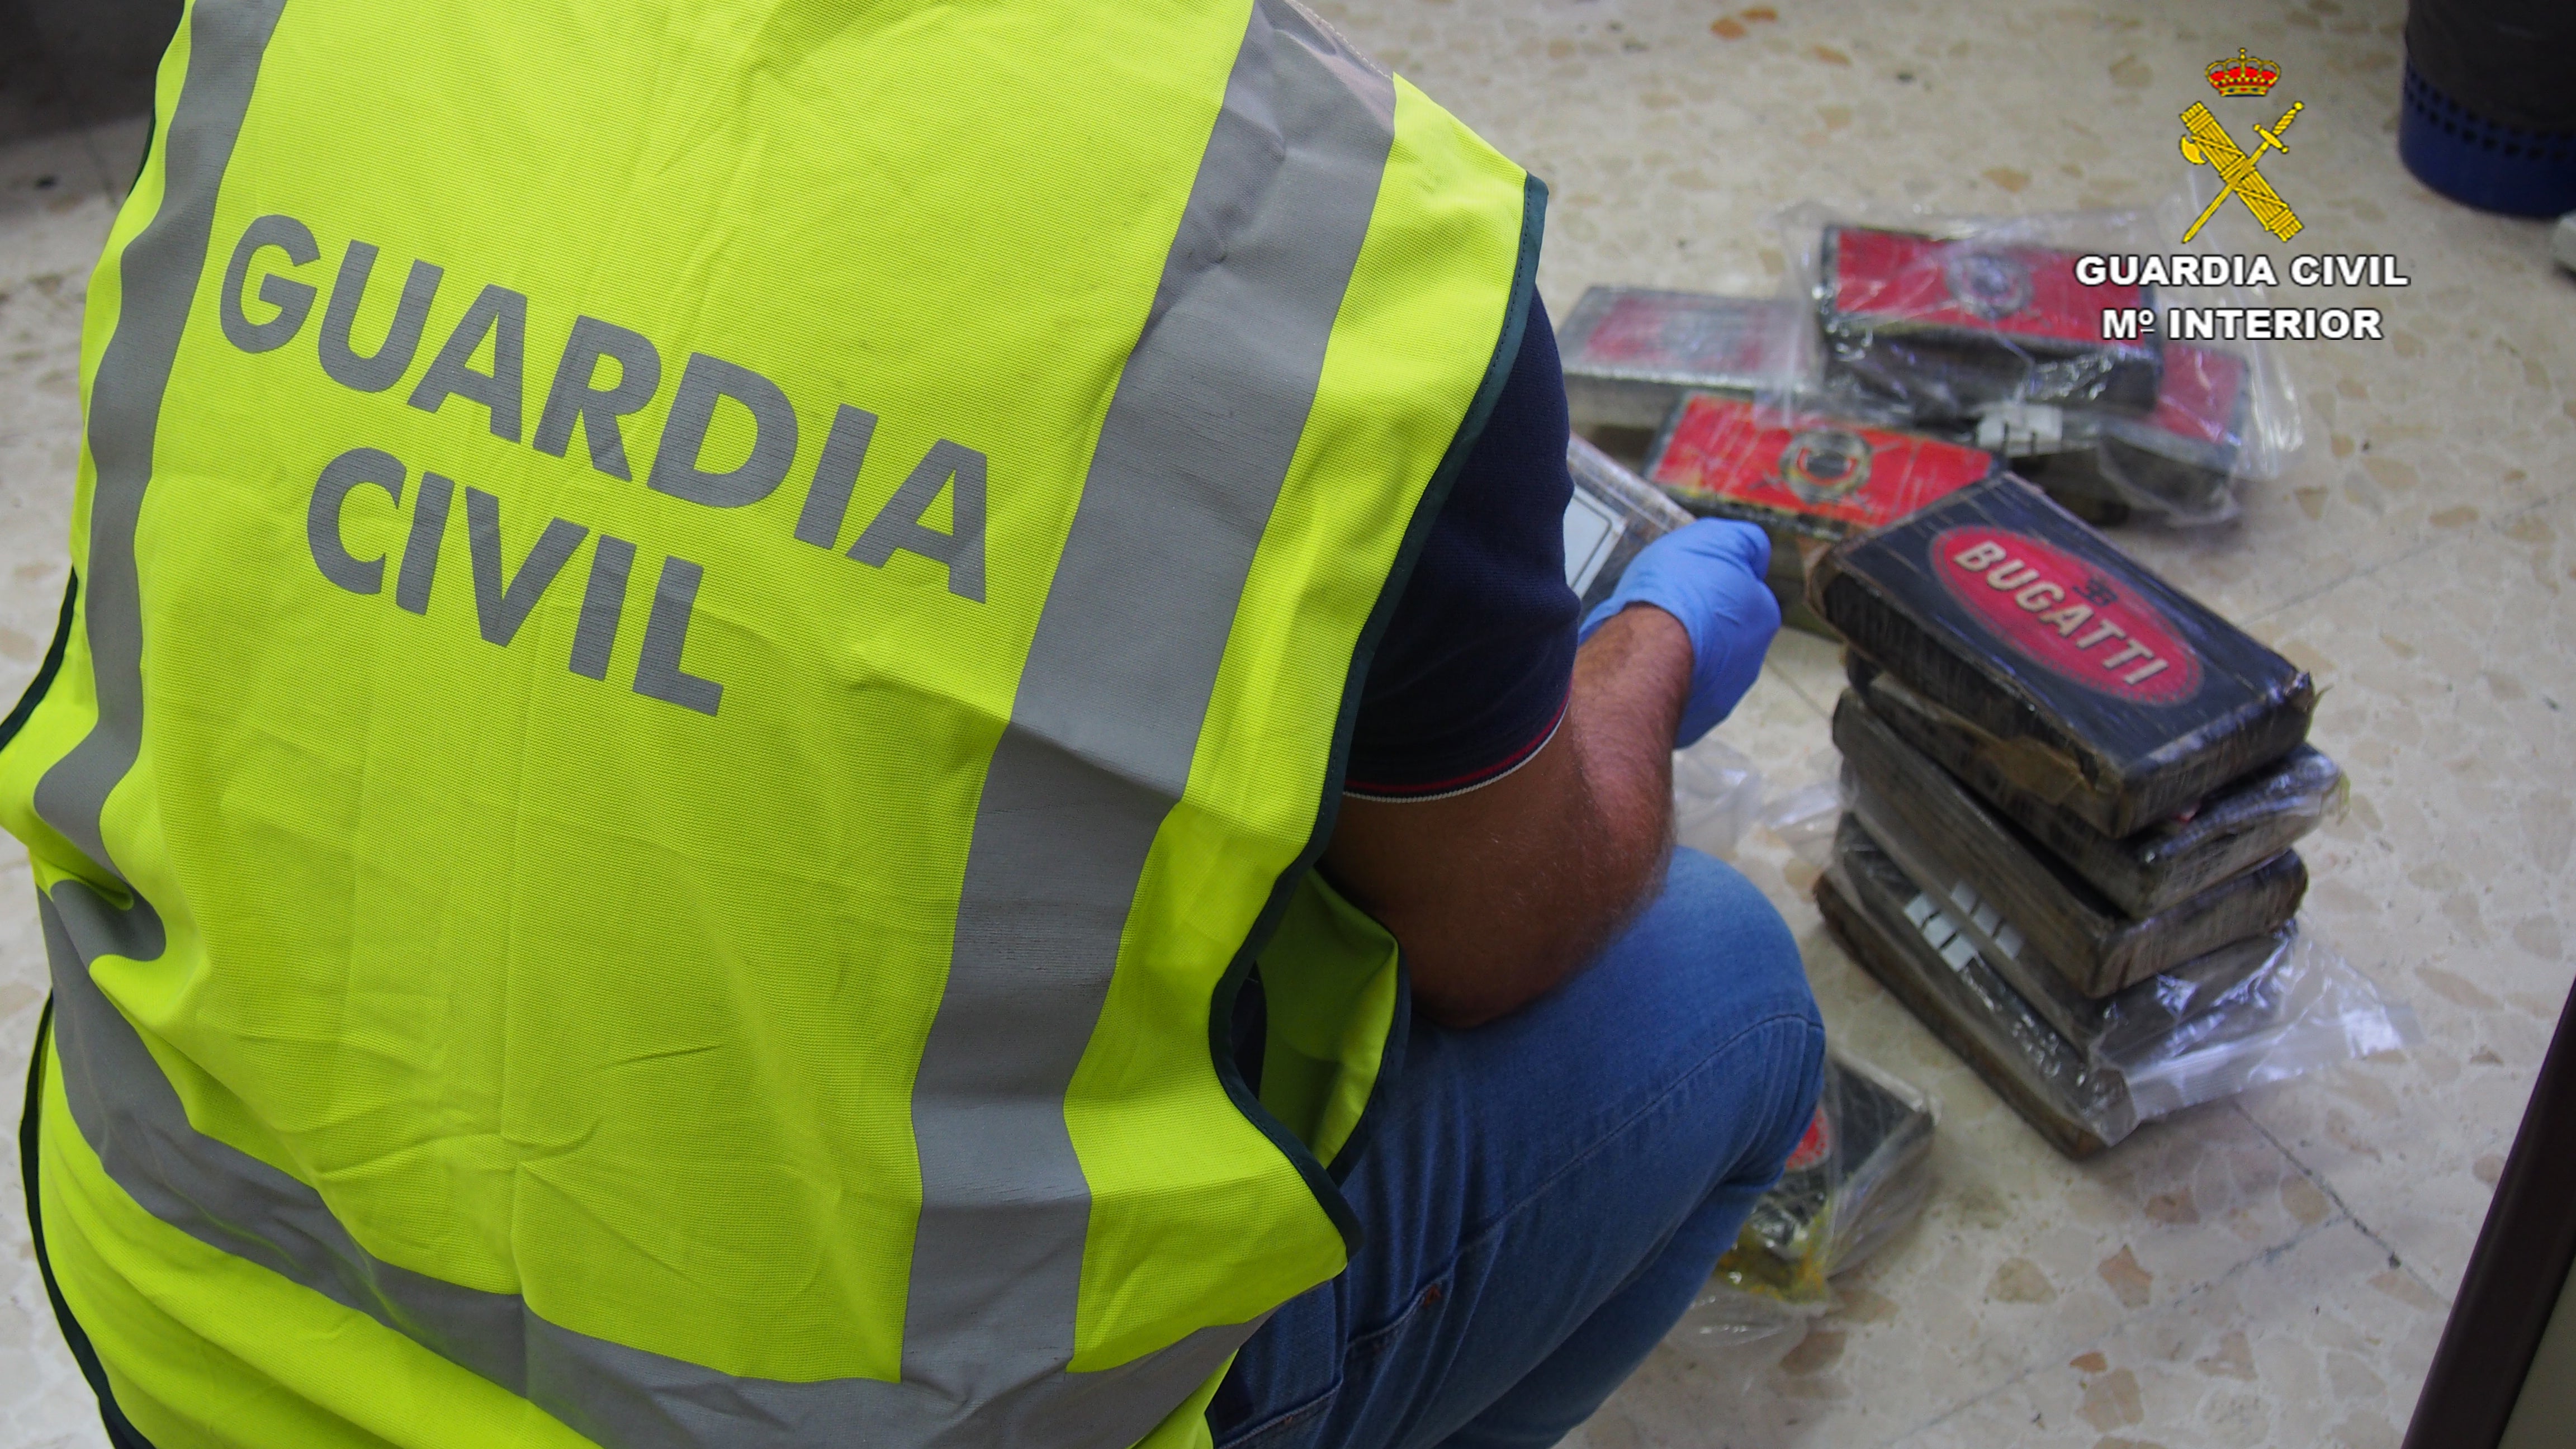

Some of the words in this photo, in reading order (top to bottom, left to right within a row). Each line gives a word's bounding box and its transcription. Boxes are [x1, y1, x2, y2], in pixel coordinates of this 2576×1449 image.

[219, 214, 988, 604] GUARDIA
[306, 447, 725, 717] CIVIL
[1953, 539, 2170, 686] BUGATTI
